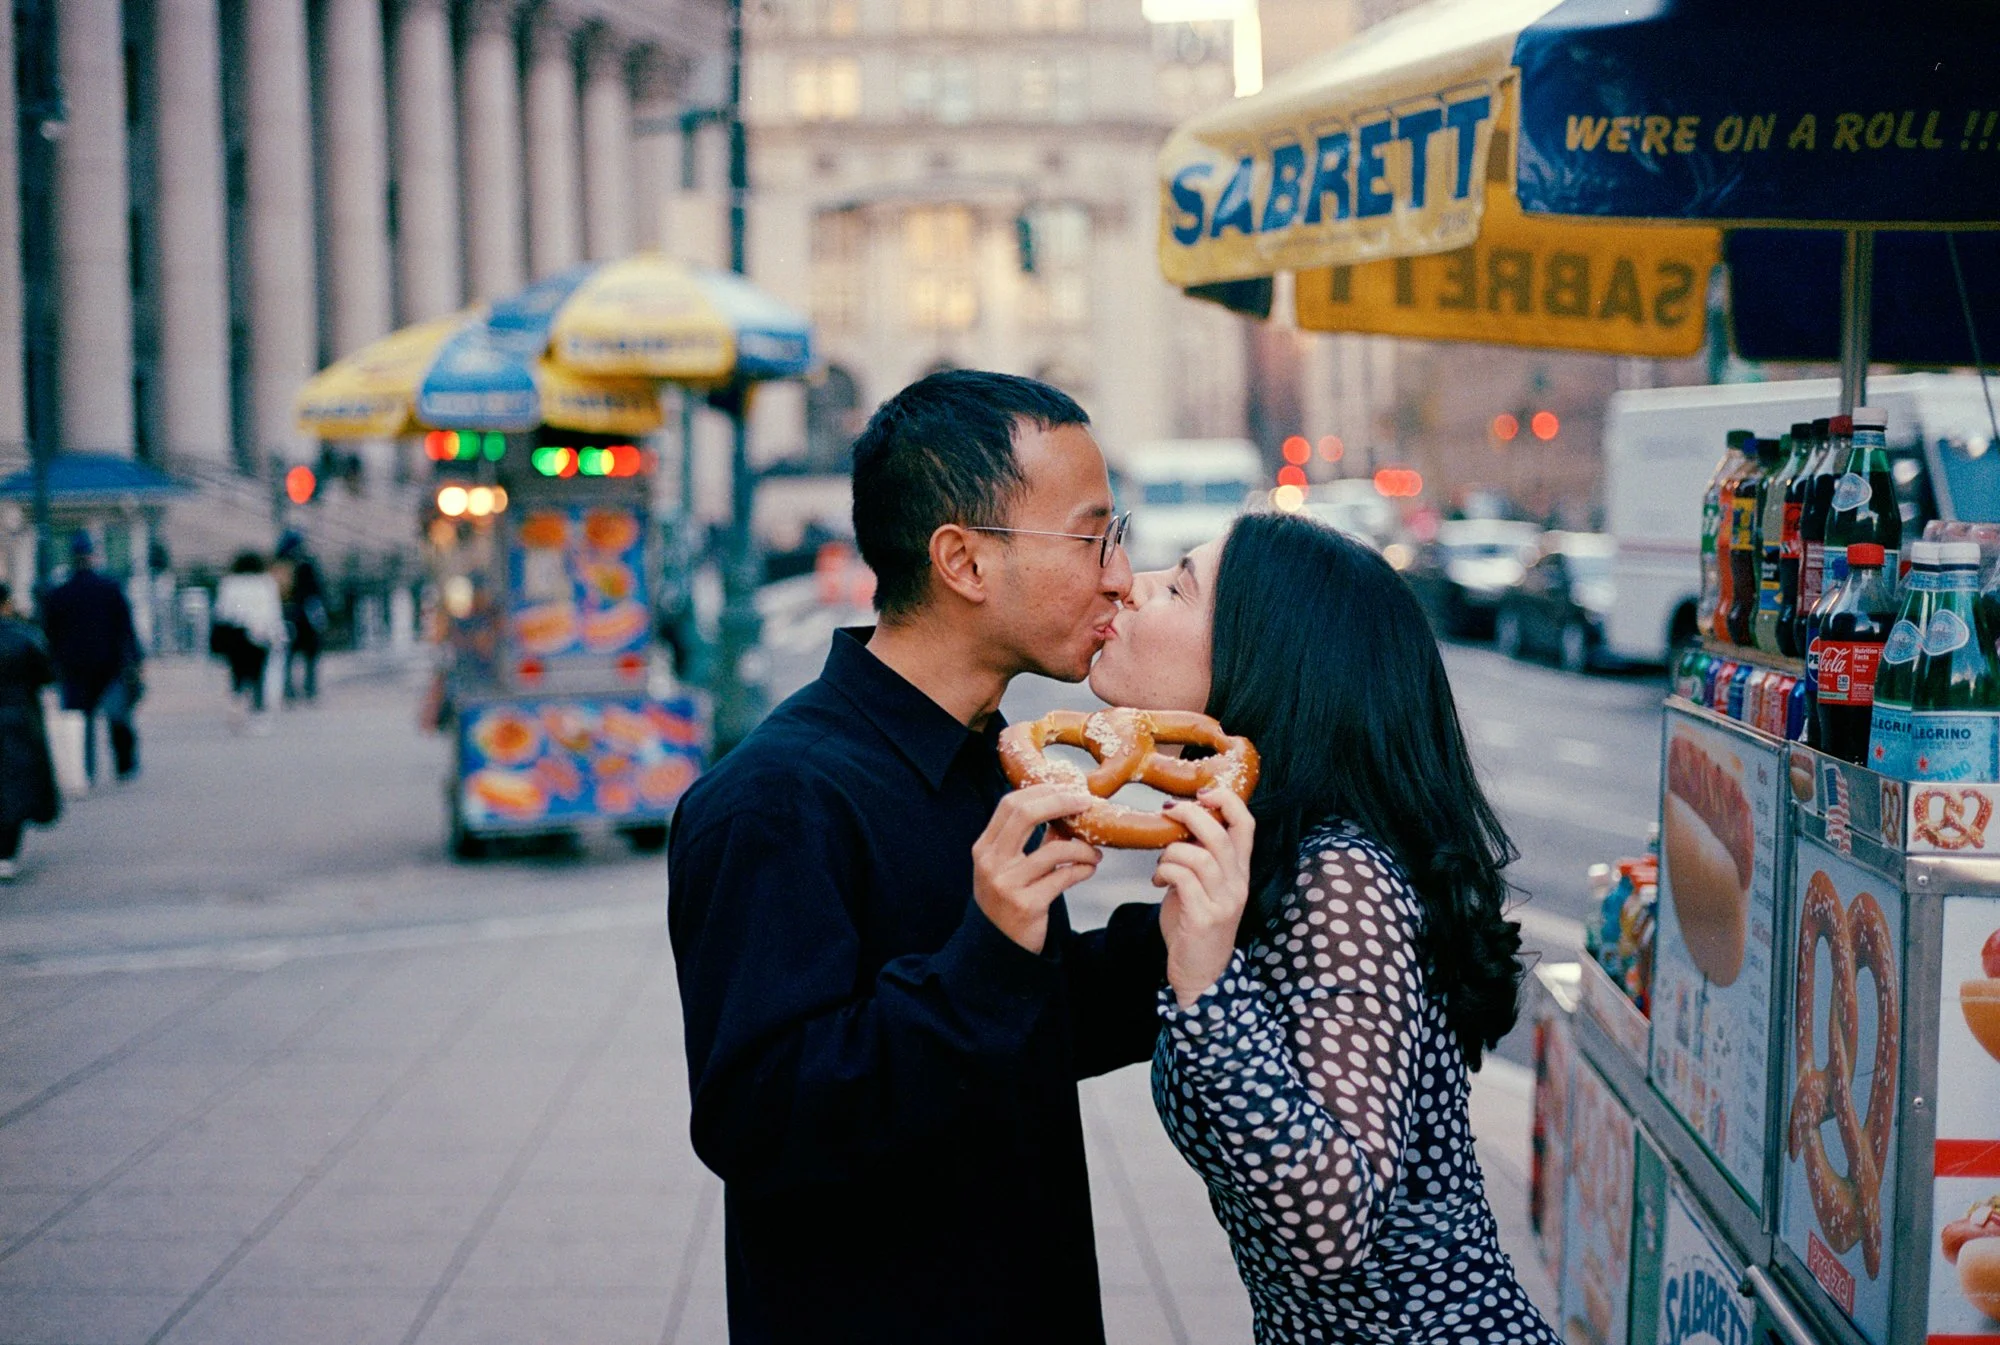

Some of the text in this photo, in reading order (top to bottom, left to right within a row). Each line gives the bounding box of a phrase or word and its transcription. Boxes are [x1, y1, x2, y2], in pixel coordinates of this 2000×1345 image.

[1171, 95, 1491, 246] SABRETT
[1565, 114, 1701, 156] WE'RE
[1714, 112, 1777, 152] ON
[1788, 113, 1817, 151] A
[1833, 110, 1943, 153] ROLL
[1665, 1269, 1749, 1345] SABRETT
